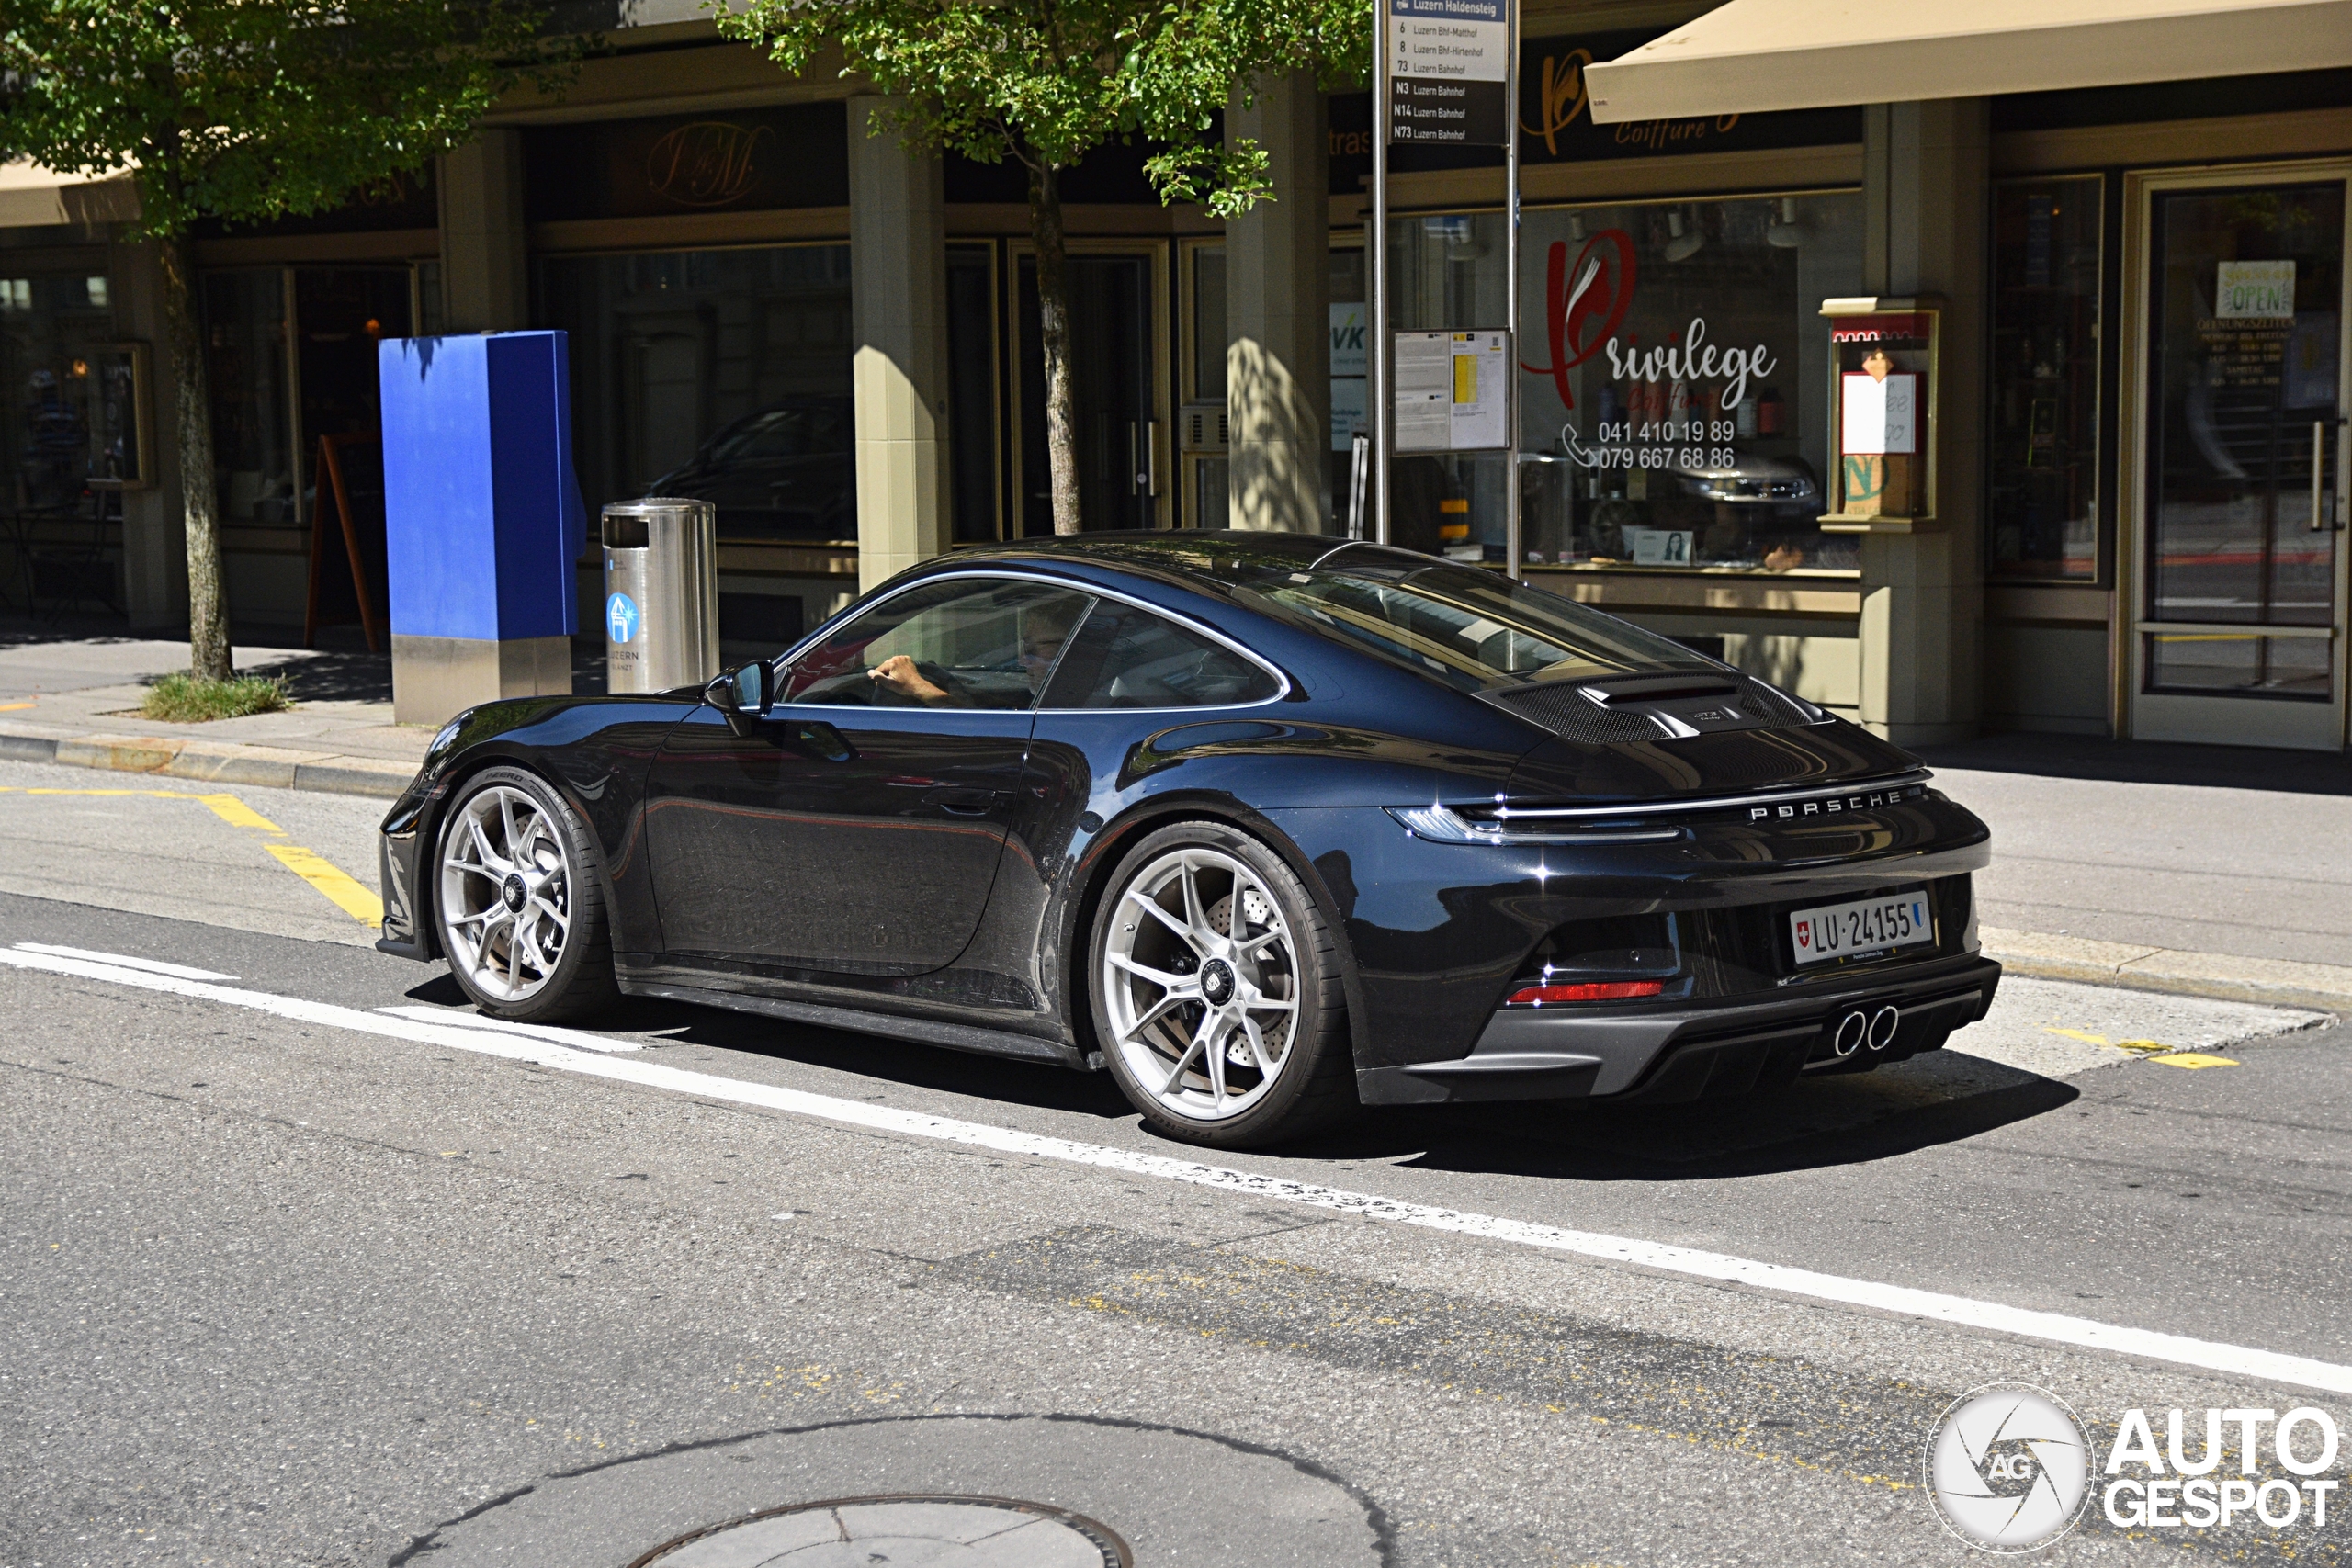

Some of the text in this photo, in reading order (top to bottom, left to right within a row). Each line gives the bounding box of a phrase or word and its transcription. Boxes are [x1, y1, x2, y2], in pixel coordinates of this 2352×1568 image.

[1413, 0, 1497, 17] Luzern Haldensteig
[1399, 22, 1478, 38] 6 Luzern Bhf-Matthof
[1399, 41, 1484, 57] 8 Luzern Bhf-Hirtenhof
[1397, 60, 1466, 75] 73 Luzern Bahnhof
[1396, 82, 1466, 96] N3 Luzern Bahnhof
[1394, 104, 1466, 119] N14 Luzern Bahnhof
[1394, 126, 1466, 141] N73 Luzern Bahnhof
[1615, 118, 1706, 149] Coiffure
[2233, 285, 2282, 311] OPEN
[1599, 421, 1735, 443] 041 410 19 89
[1599, 447, 1735, 468] 079 667 68 86
[1750, 791, 1902, 821] PORSCHE
